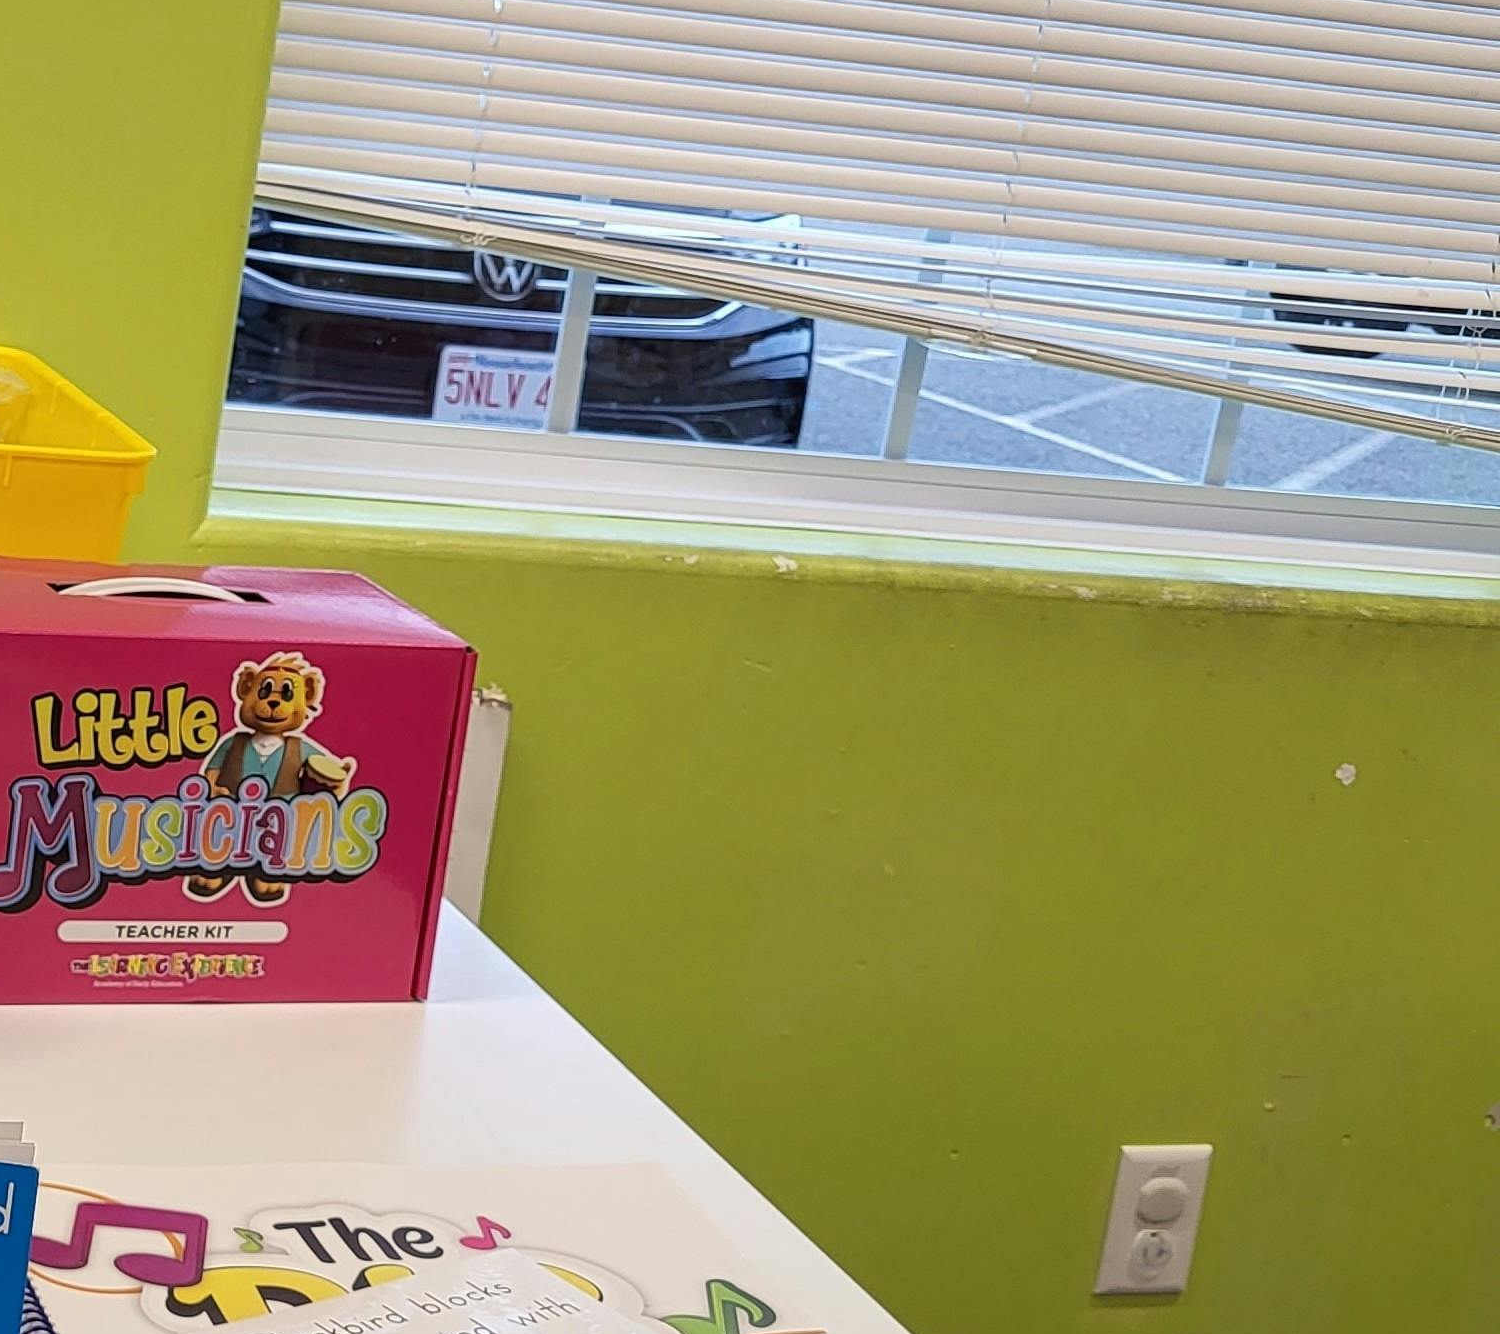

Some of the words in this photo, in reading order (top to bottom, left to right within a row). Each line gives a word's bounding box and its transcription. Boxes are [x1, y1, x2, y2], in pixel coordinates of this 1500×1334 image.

[444, 368, 526, 409] 5NLV
[31, 684, 219, 770] Little
[116, 925, 199, 939] TEACHER
[205, 925, 234, 939] KIT
[273, 1216, 444, 1264] The
[407, 1280, 512, 1315] blocks
[507, 1296, 581, 1327] with
